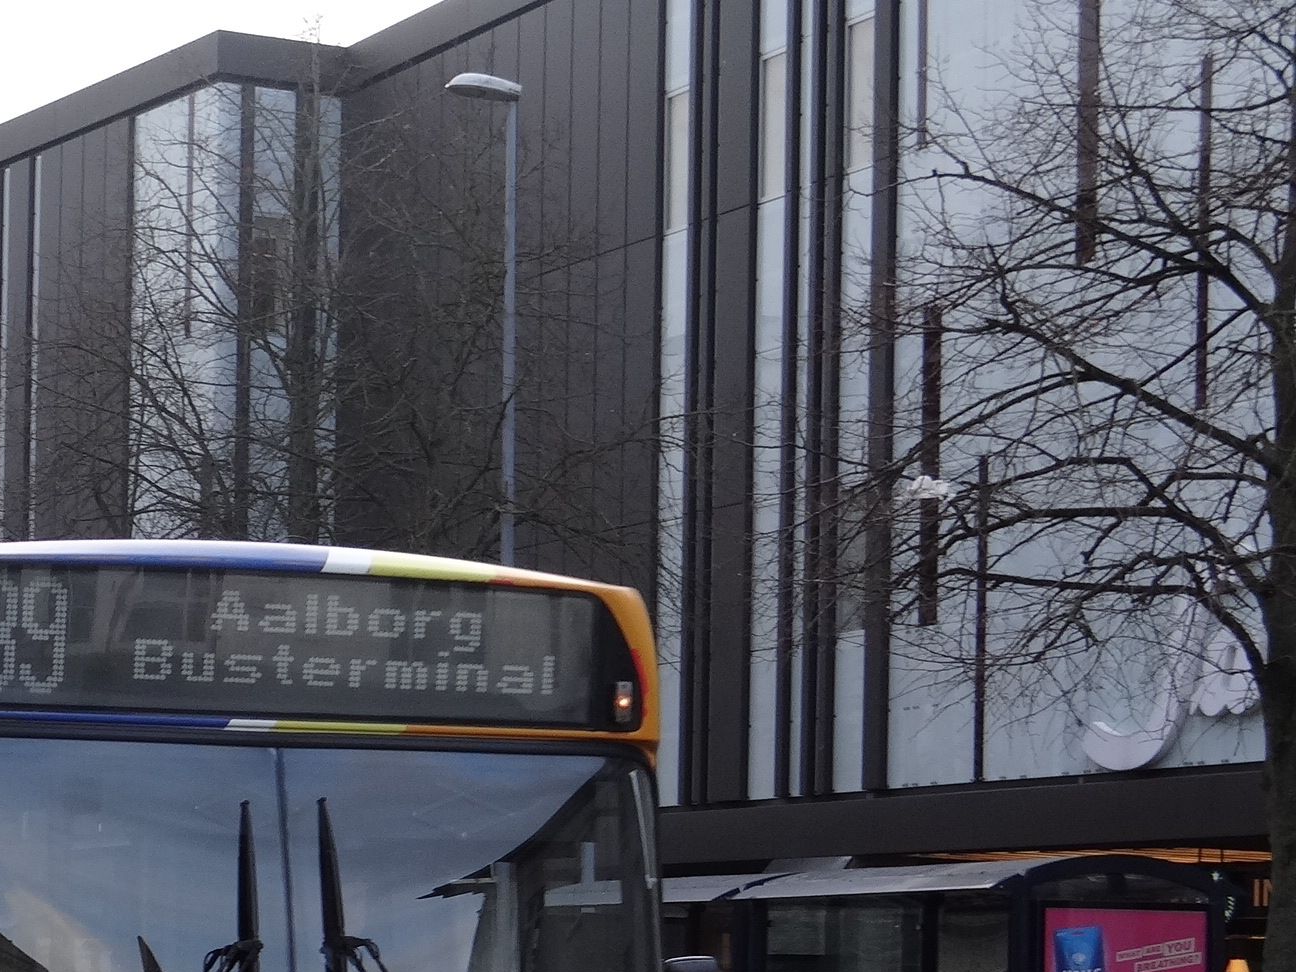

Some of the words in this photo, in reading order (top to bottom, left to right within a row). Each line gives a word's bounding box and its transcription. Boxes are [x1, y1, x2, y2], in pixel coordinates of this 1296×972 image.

[209, 588, 484, 653] Aalborg
[133, 637, 558, 696] Busterminal
[1167, 940, 1192, 954] YOU
